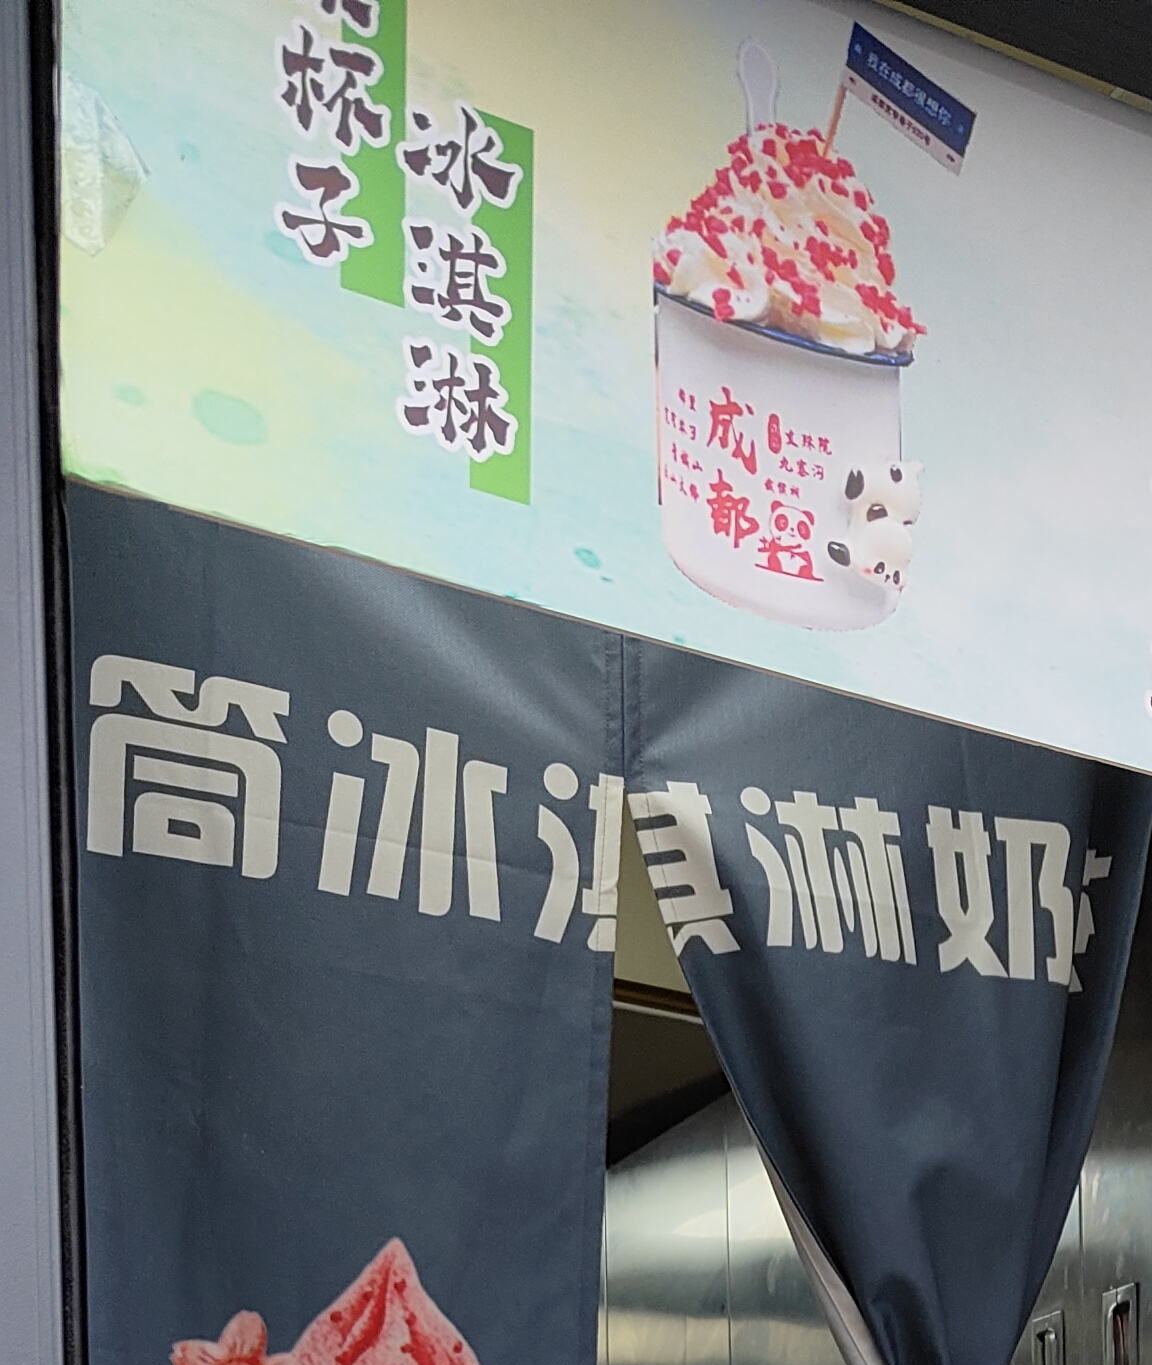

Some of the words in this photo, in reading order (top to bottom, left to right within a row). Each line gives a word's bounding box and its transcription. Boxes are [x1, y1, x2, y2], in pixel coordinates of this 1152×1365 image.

[281, 0, 385, 258] 杯子
[866, 52, 951, 126] 我在成都很想你
[401, 106, 516, 454] 冰淇淋
[706, 386, 760, 549] 成都
